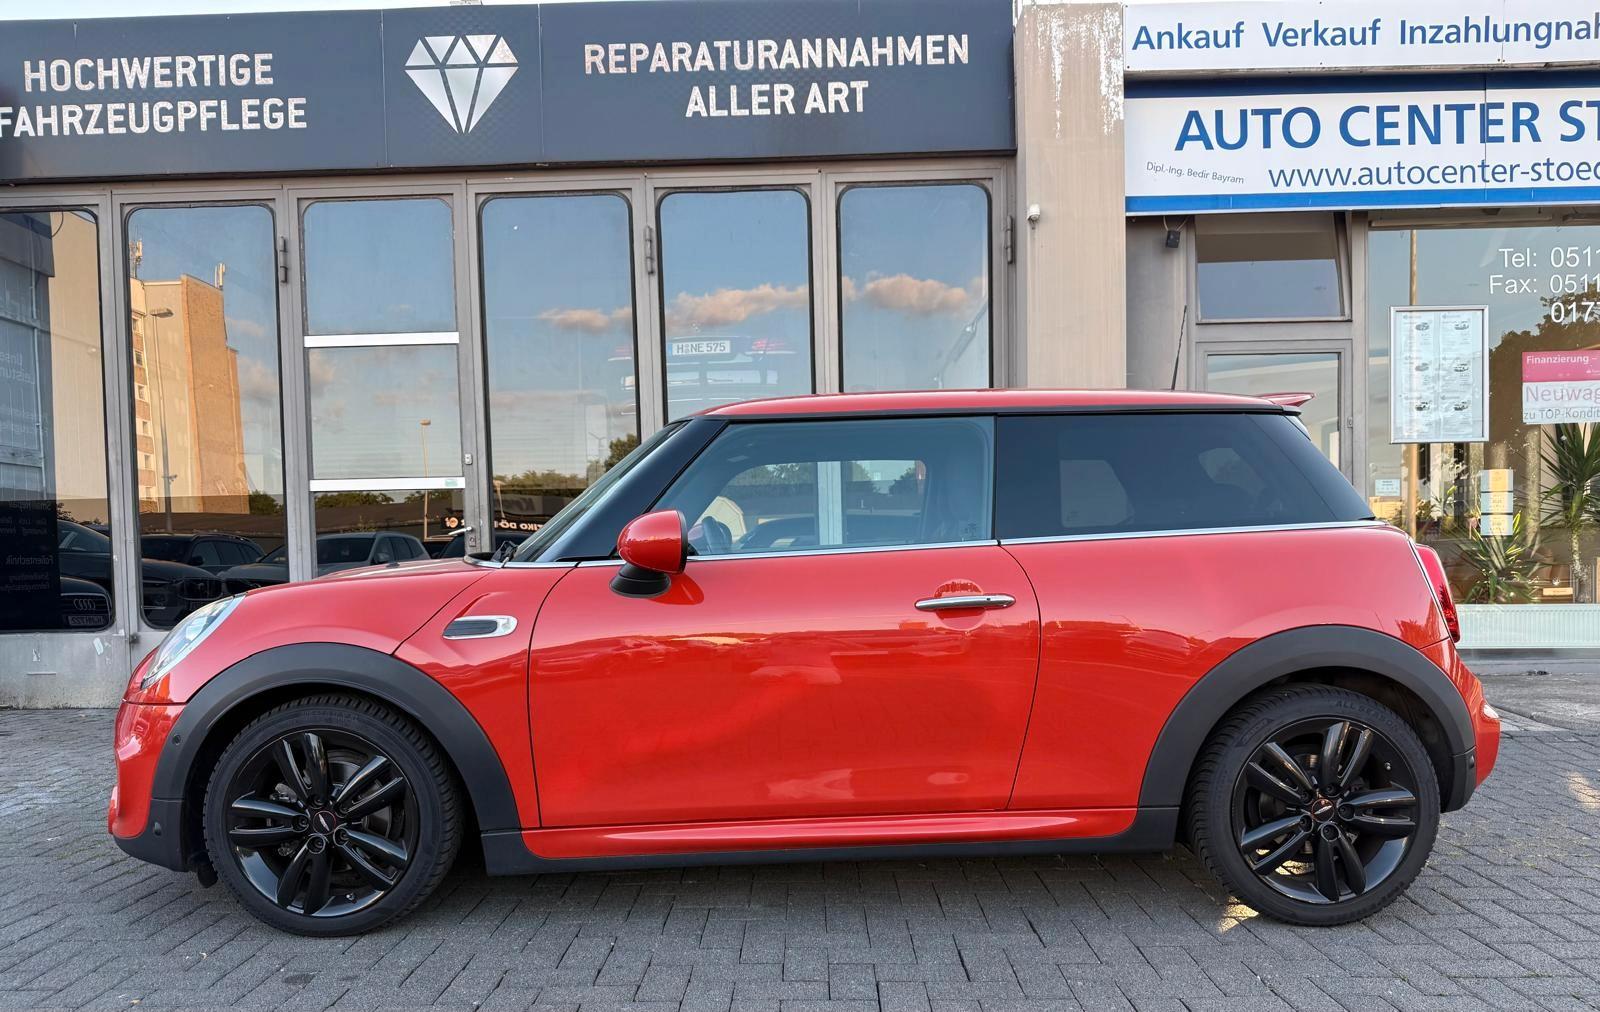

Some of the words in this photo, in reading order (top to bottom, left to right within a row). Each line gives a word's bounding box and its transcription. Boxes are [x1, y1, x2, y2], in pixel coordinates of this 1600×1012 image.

[1131, 22, 1245, 51] Ankauf
[1262, 18, 1381, 47] Verkauf
[584, 34, 969, 75] REPARATURANNAHMEN
[24, 53, 274, 93] HOCHWERTIGE
[685, 83, 795, 118] ALLER
[804, 80, 869, 114] ART
[0, 97, 307, 138] FAHRZEUGPFLEGE
[1174, 106, 1321, 151] AUTO
[1339, 101, 1542, 147] CENTER
[1187, 168, 1210, 179] Bedir
[1212, 171, 1244, 184] Bayram
[1498, 247, 1537, 268] Tel:
[1489, 274, 1537, 294] Fax:
[1550, 301, 1600, 323] 017
[706, 342, 726, 352] 575
[1526, 354, 1589, 365] Finanzierung
[1523, 412, 1536, 420] zu
